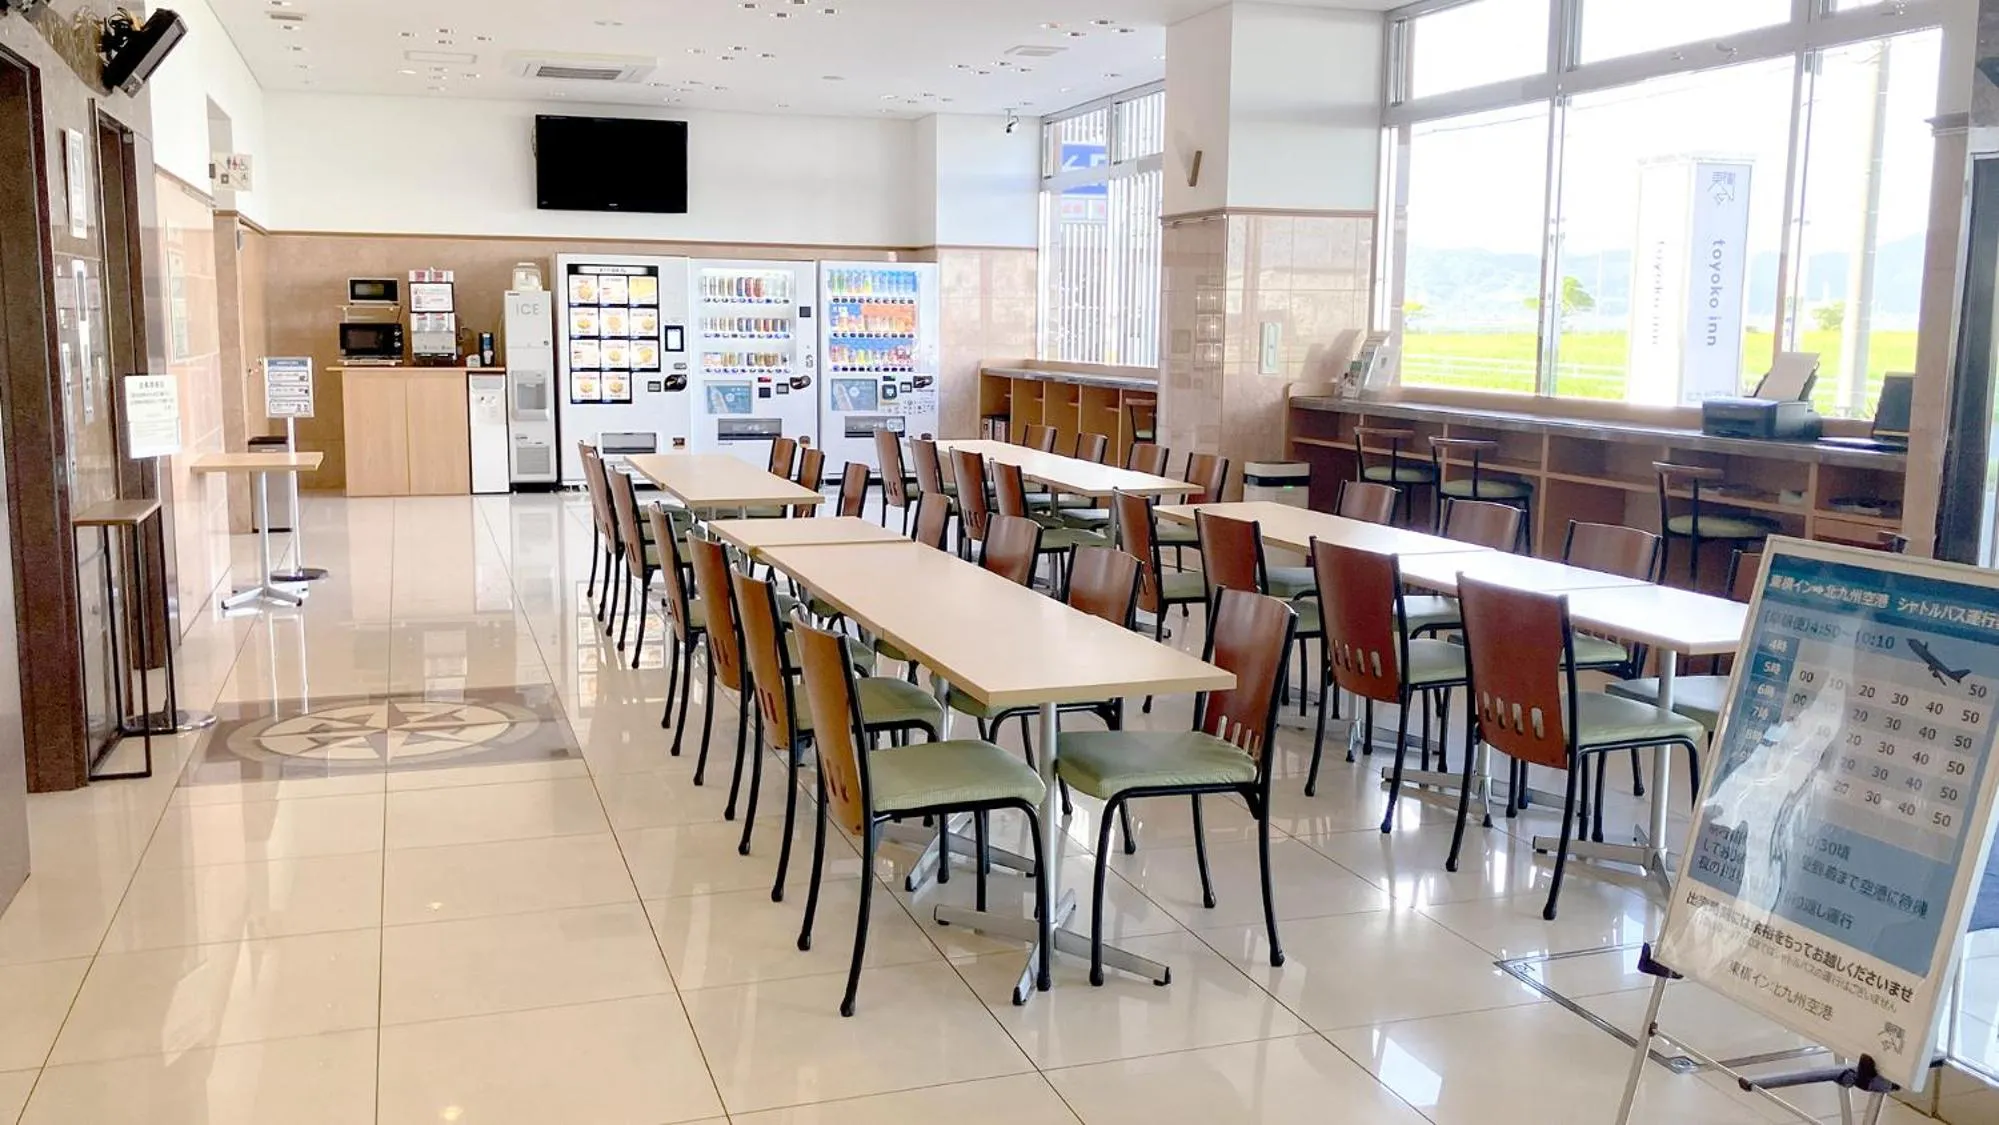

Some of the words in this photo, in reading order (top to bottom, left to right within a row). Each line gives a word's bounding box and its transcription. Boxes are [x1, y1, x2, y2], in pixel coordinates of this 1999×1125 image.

[1709, 239, 1726, 308] toyoko
[516, 303, 540, 316] ICE
[1707, 315, 1722, 346] inn
[1800, 670, 1814, 683] 00
[1858, 685, 1876, 698] 20
[1891, 692, 1909, 706] 30
[1925, 702, 1944, 715] 40
[1961, 709, 1980, 724] 50
[1968, 683, 1987, 698] 50
[1793, 693, 1807, 706] 00
[1852, 709, 1868, 722] 20
[1884, 716, 1902, 731] 30
[1918, 726, 1936, 740] 40
[1953, 735, 1972, 749] 50
[1846, 733, 1861, 746] 20
[1878, 741, 1895, 755] 30
[1912, 751, 1929, 765] 40
[1946, 760, 1965, 775] 50
[1840, 757, 1855, 770] 20
[1871, 766, 1888, 780] 30
[1905, 777, 1922, 791] 40
[1940, 786, 1957, 801] 50
[1833, 780, 1849, 794] 20
[1865, 790, 1881, 805] 30
[1898, 802, 1915, 816] 40
[1932, 812, 1951, 827] 50
